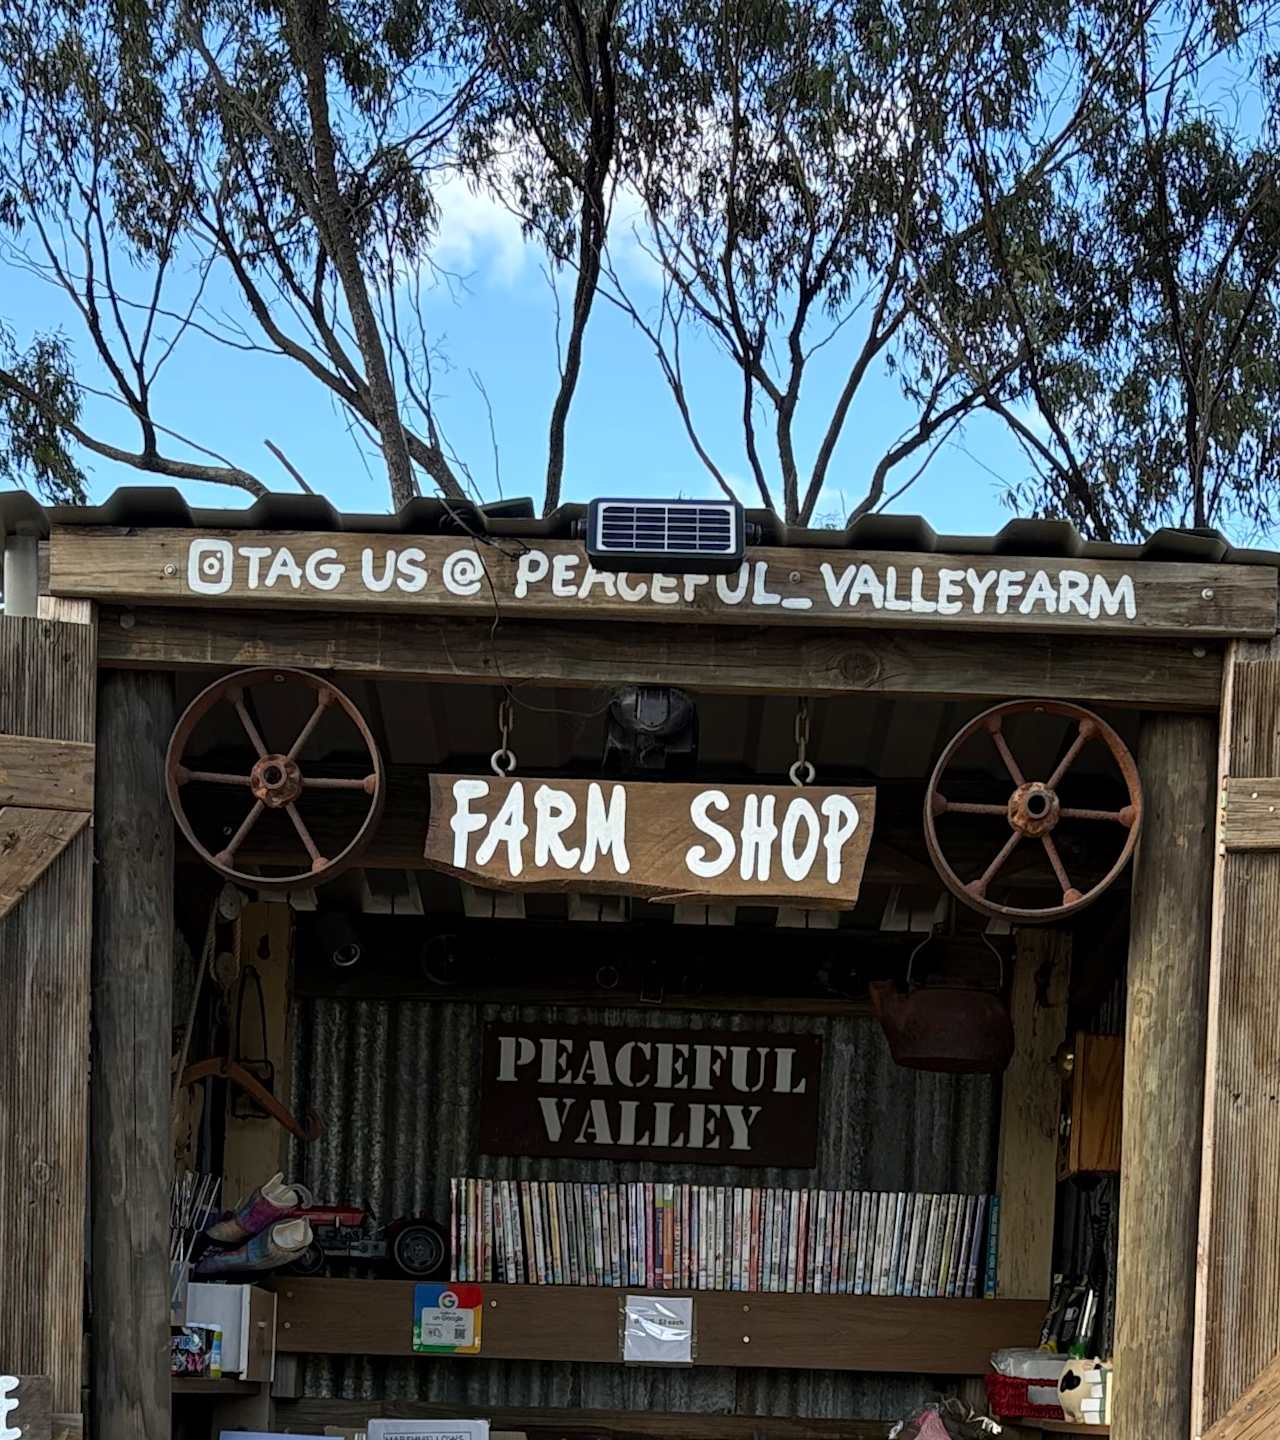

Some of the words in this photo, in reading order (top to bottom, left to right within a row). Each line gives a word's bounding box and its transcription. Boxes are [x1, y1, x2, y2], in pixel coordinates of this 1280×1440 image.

[238, 546, 346, 592] TAG
[361, 548, 428, 593] US
[442, 549, 485, 595] @
[450, 778, 630, 877] FARM
[685, 789, 859, 884] SHOP
[496, 1036, 807, 1094] PEACEFUL
[537, 1096, 763, 1151] VALLEY
